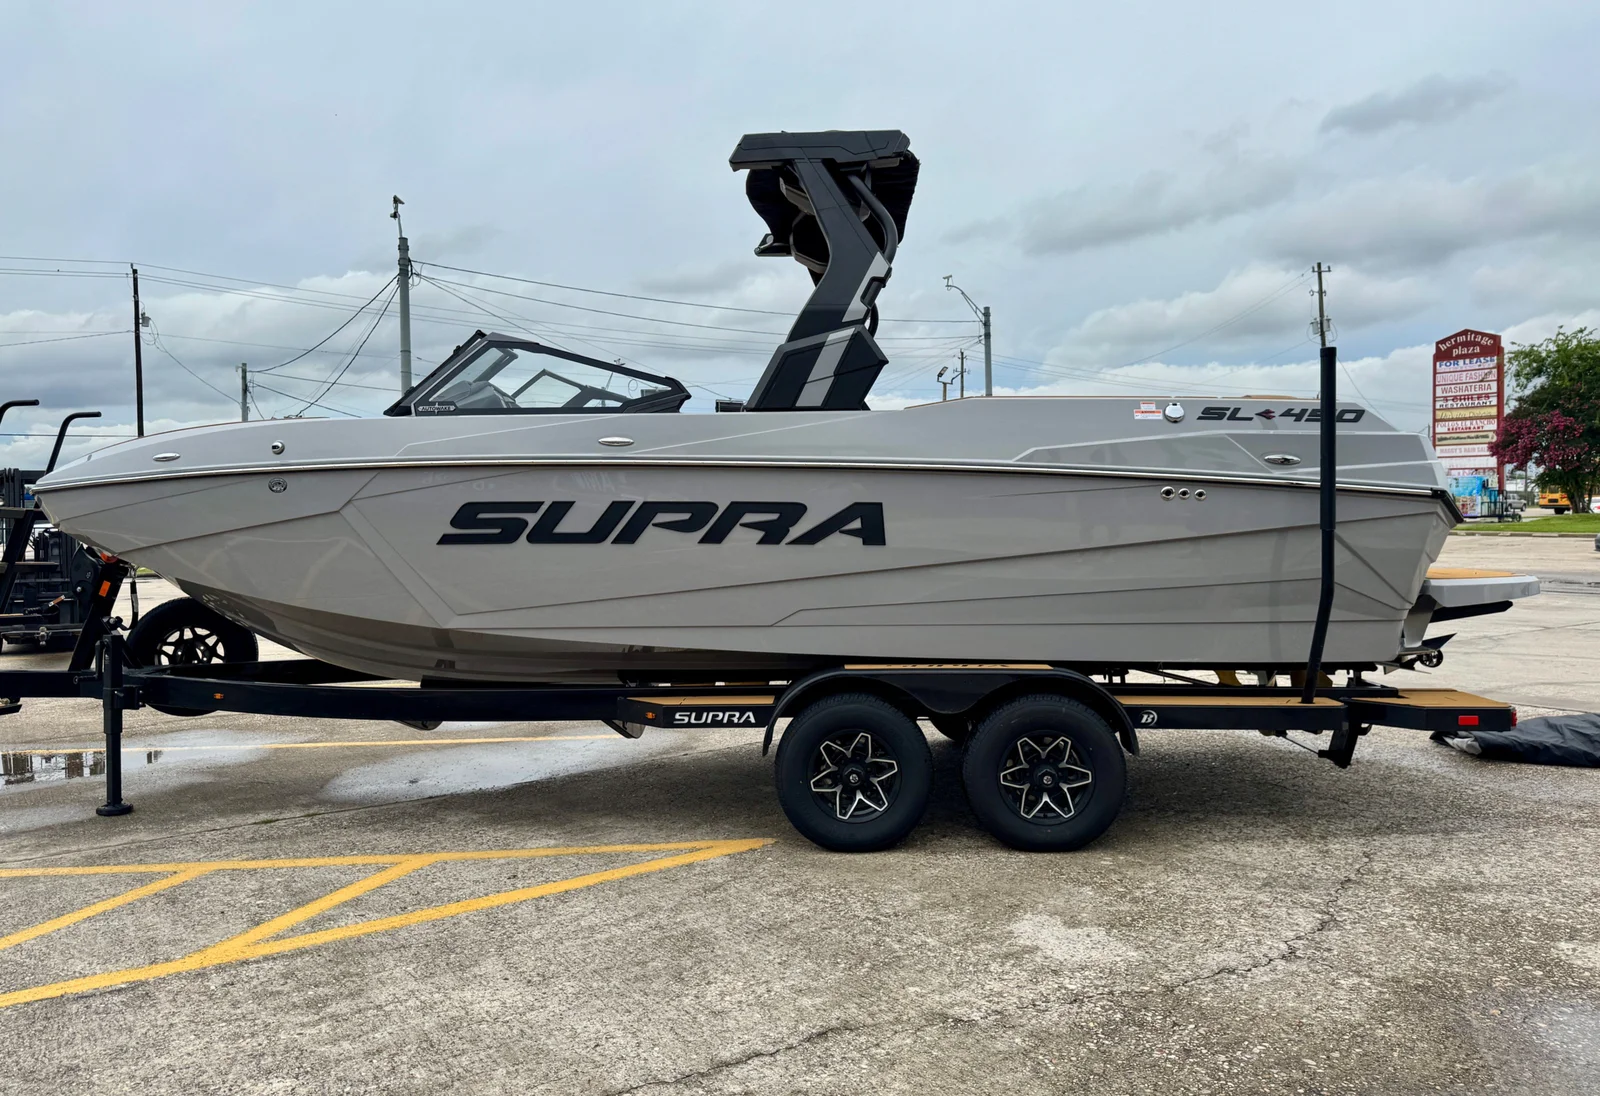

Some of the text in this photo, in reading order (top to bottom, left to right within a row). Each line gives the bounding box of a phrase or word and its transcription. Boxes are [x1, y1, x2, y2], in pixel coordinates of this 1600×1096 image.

[1438, 332, 1493, 351] hermitage
[1452, 345, 1480, 357] plaza
[1439, 360, 1460, 368] FOR
[1463, 356, 1495, 365] LEASE
[1436, 373, 1464, 383] UNIQUE
[1441, 384, 1492, 394] WASHATERIA
[1439, 400, 1493, 408] RESTAURANT
[1197, 406, 1254, 421] SL
[436, 500, 887, 546] SUPRA
[674, 711, 757, 724] SUPRA
